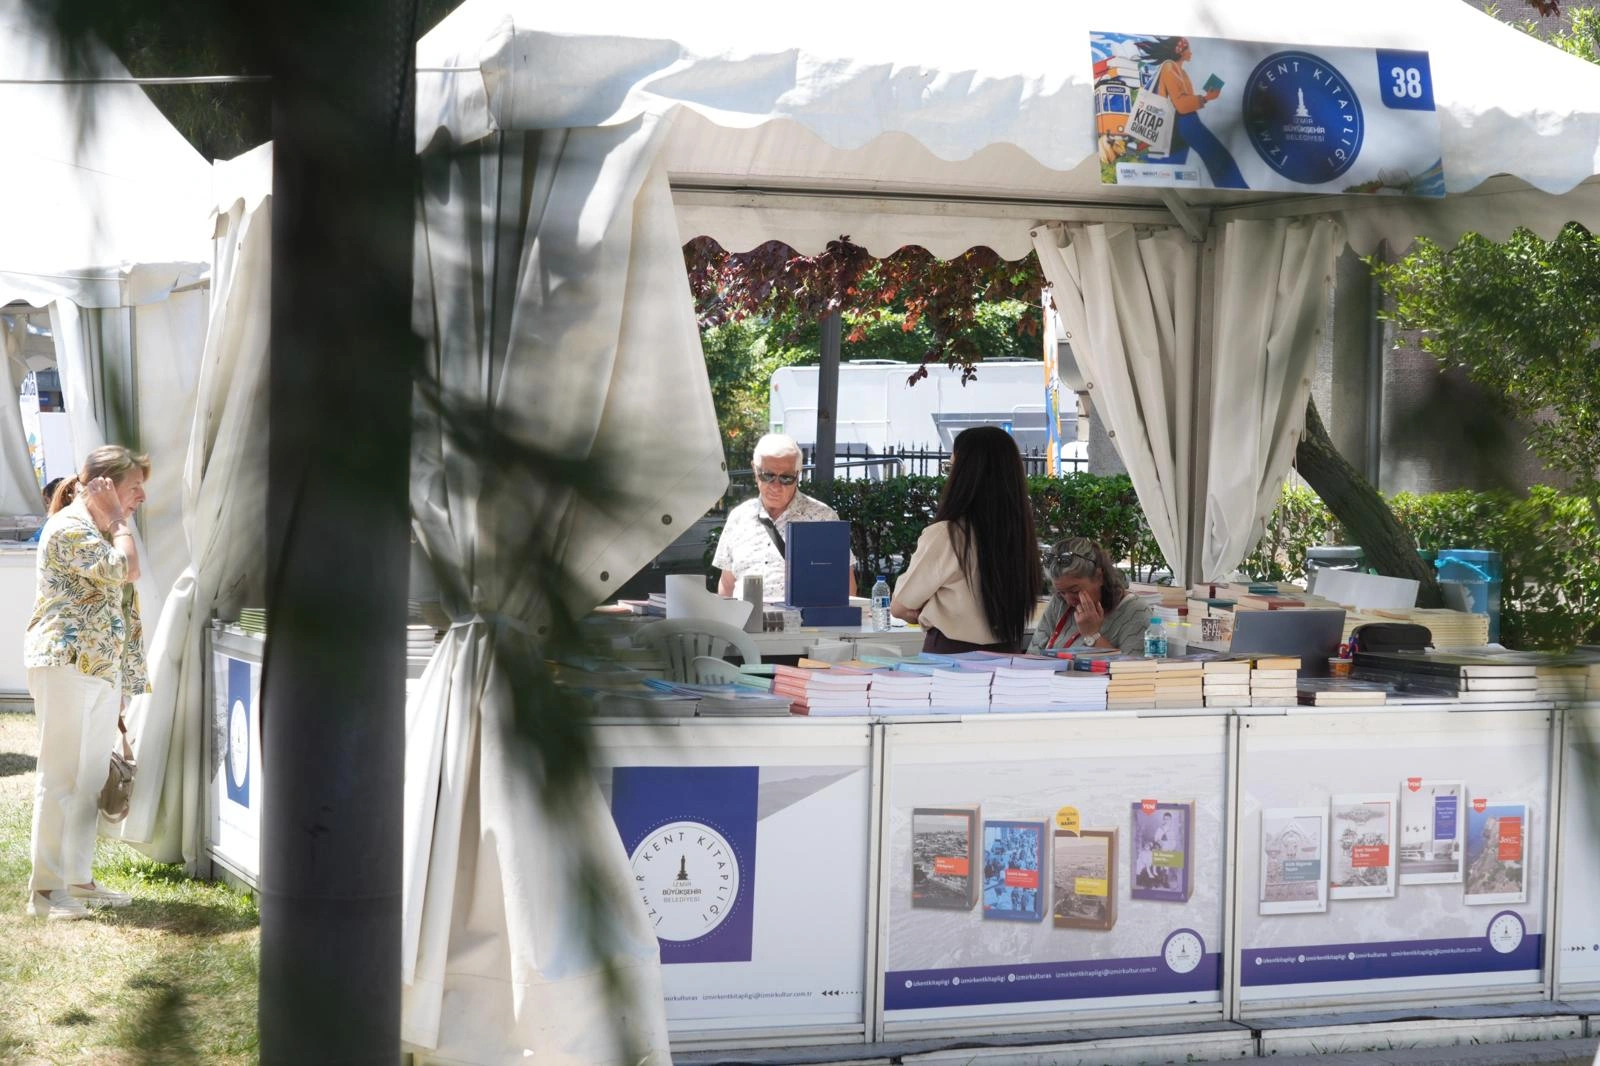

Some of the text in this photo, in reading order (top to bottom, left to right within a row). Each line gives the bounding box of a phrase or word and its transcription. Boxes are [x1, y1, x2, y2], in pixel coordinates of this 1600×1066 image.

[1391, 66, 1422, 98] 38
[1134, 108, 1165, 131] KİTAP
[1130, 121, 1160, 143] GÜNLERİ
[643, 832, 684, 862] KENT
[662, 888, 702, 896] BÜYÜKŞEHİR
